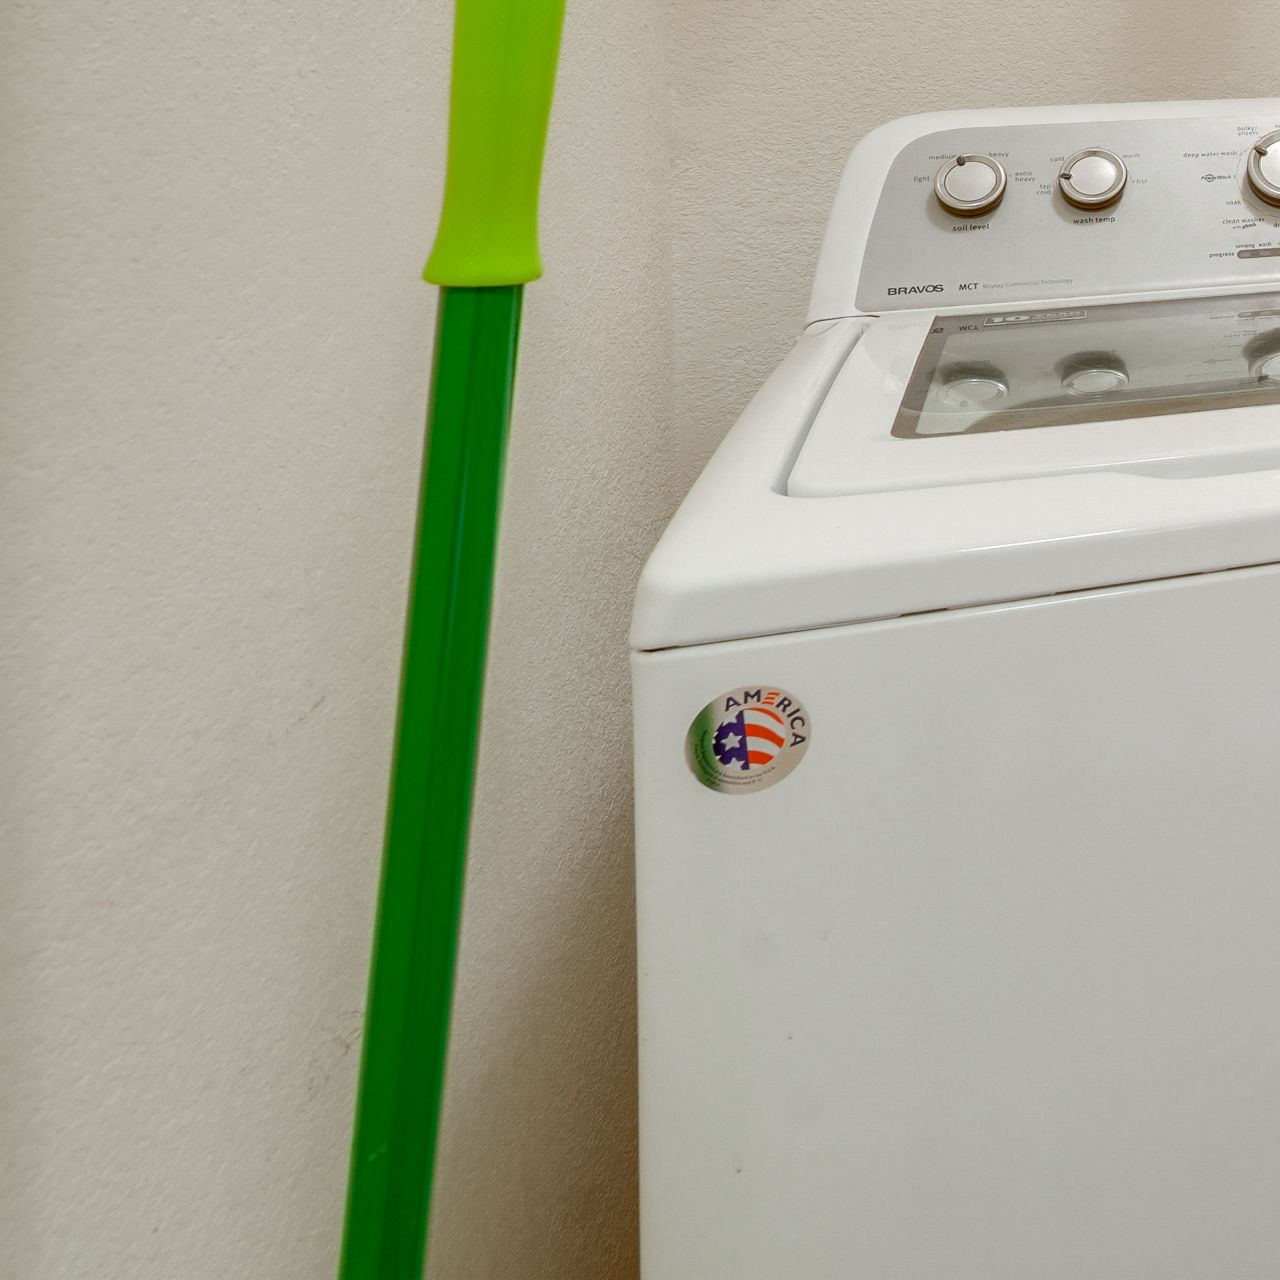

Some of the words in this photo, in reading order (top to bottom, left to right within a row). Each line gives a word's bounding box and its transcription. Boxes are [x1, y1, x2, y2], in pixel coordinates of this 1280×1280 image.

[913, 175, 930, 183] light
[1015, 176, 1035, 184] heavy
[1095, 216, 1116, 224] temp
[969, 223, 990, 231] level
[1209, 251, 1235, 259] progress
[887, 284, 944, 296] BRAVOS
[959, 283, 979, 291] MCT
[725, 688, 807, 748] AMERICA
